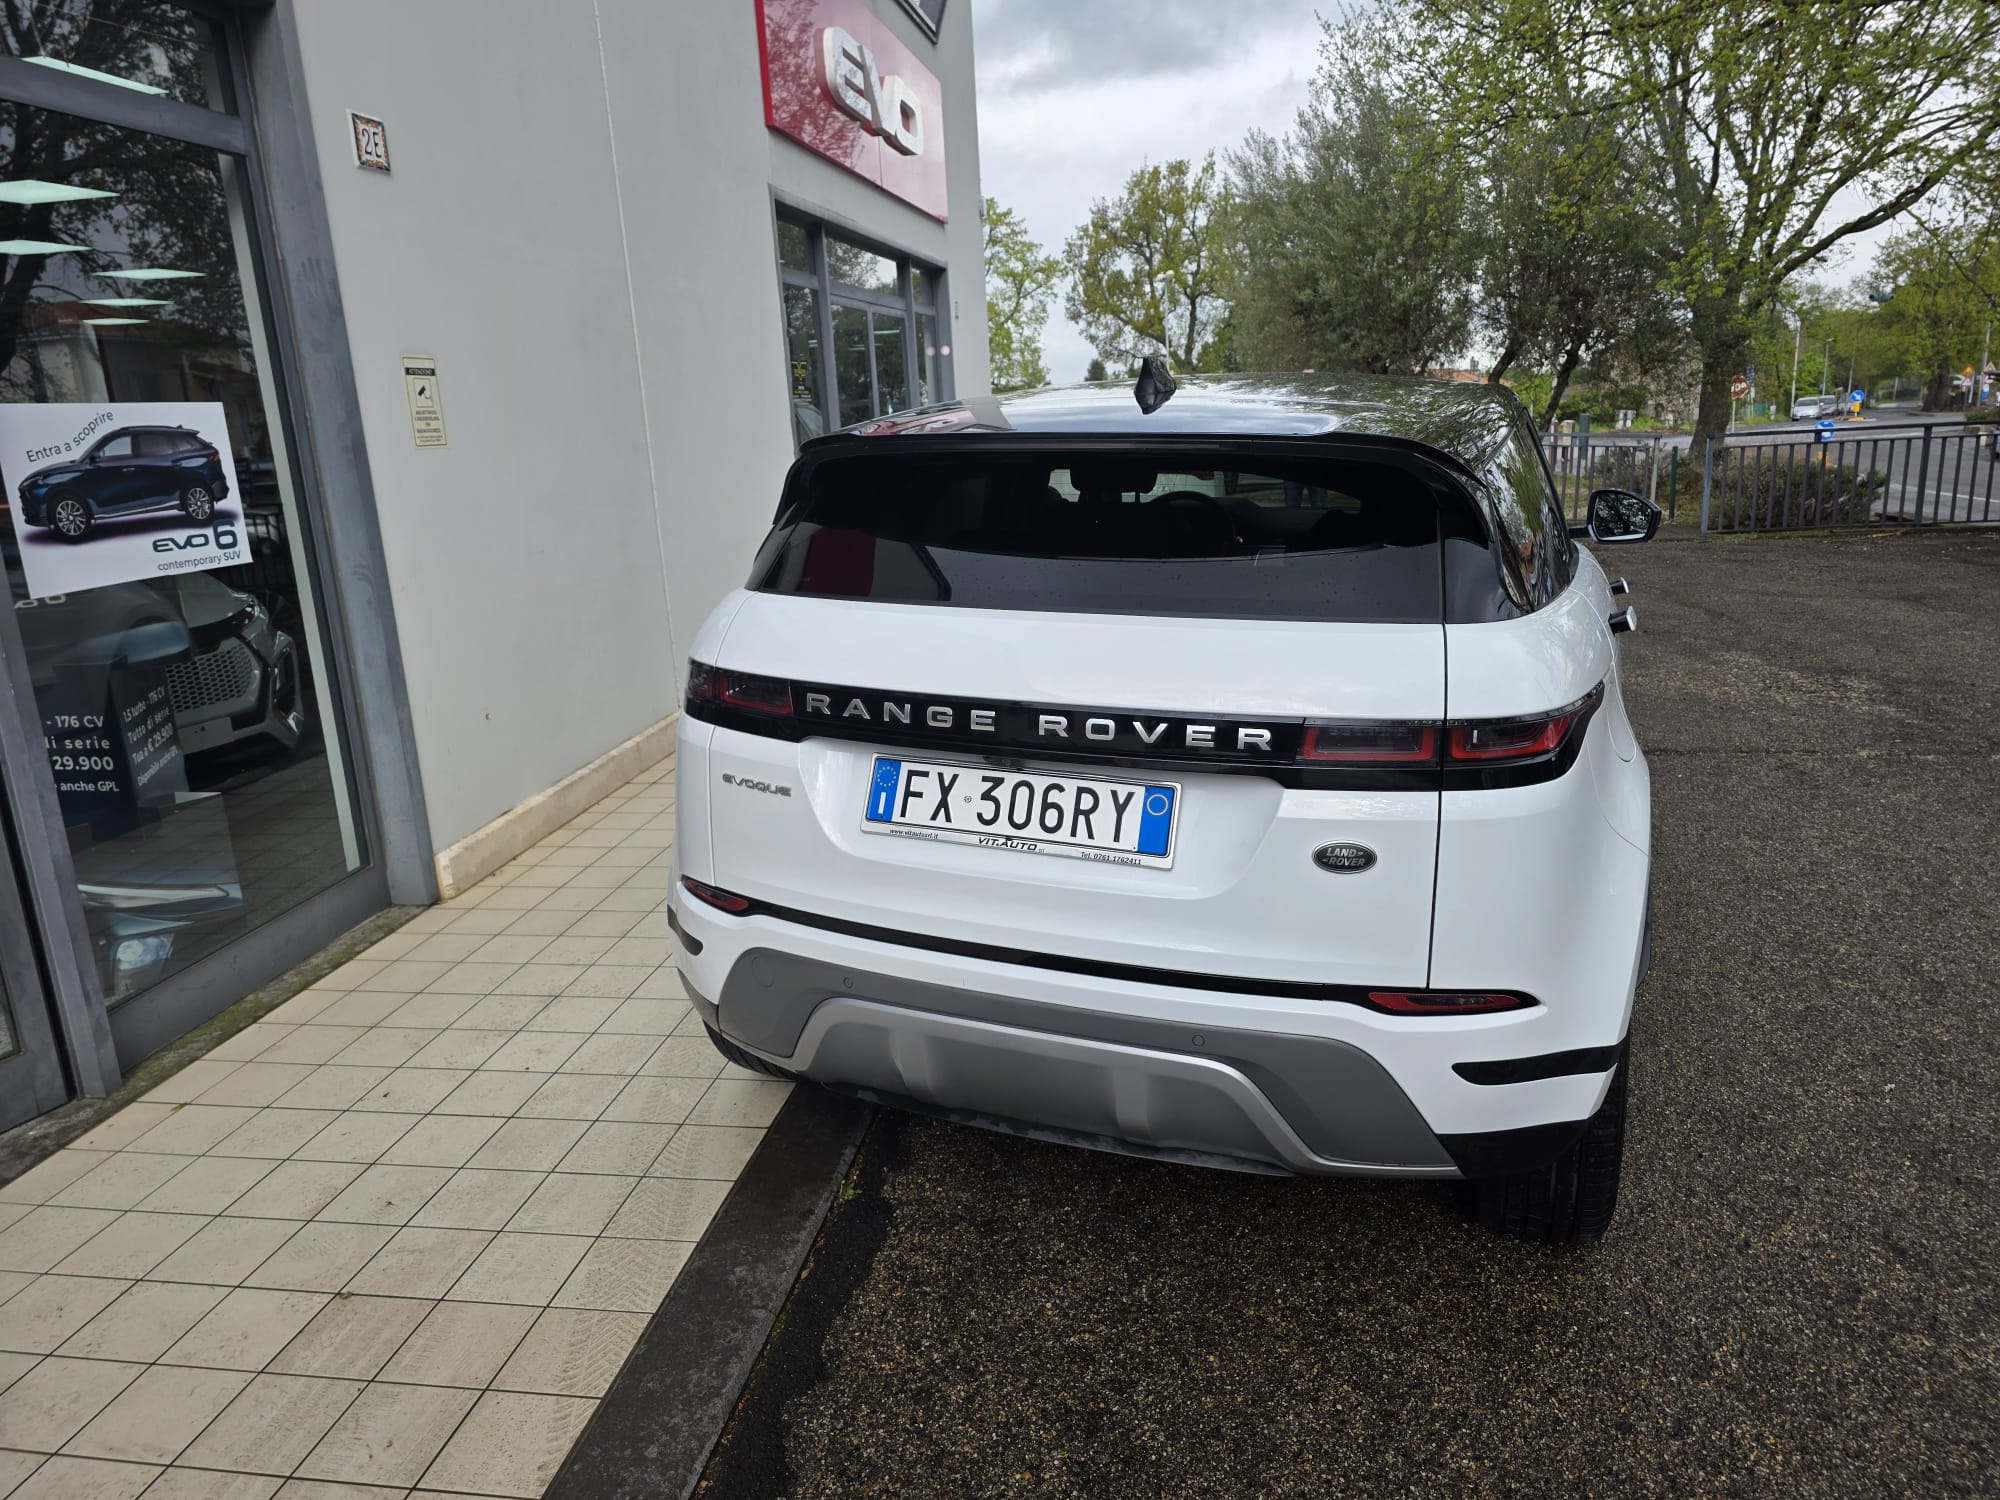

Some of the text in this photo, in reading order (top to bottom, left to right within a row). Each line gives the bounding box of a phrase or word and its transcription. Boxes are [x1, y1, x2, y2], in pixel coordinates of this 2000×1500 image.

[823, 26, 924, 156] EVO
[361, 127, 382, 159] 2E
[26, 411, 114, 463] Entra a scoprire
[152, 519, 239, 553] EVO 6
[157, 550, 241, 571] contemporary SUV
[54, 715, 80, 728] 176
[83, 715, 104, 728] CV
[806, 692, 1273, 752] RANGE ROVER
[64, 735, 111, 749] serie
[127, 724, 147, 744] Tutto
[52, 756, 114, 771] 29.900
[60, 781, 96, 792] anche
[97, 781, 121, 792] GPL
[722, 773, 792, 798] EVOQUE
[900, 769, 960, 823] FX
[976, 775, 1136, 844] 306RY
[978, 836, 1038, 851] VIT.AUTO
[1326, 847, 1357, 858] LAND
[1328, 857, 1366, 867] ROVER
